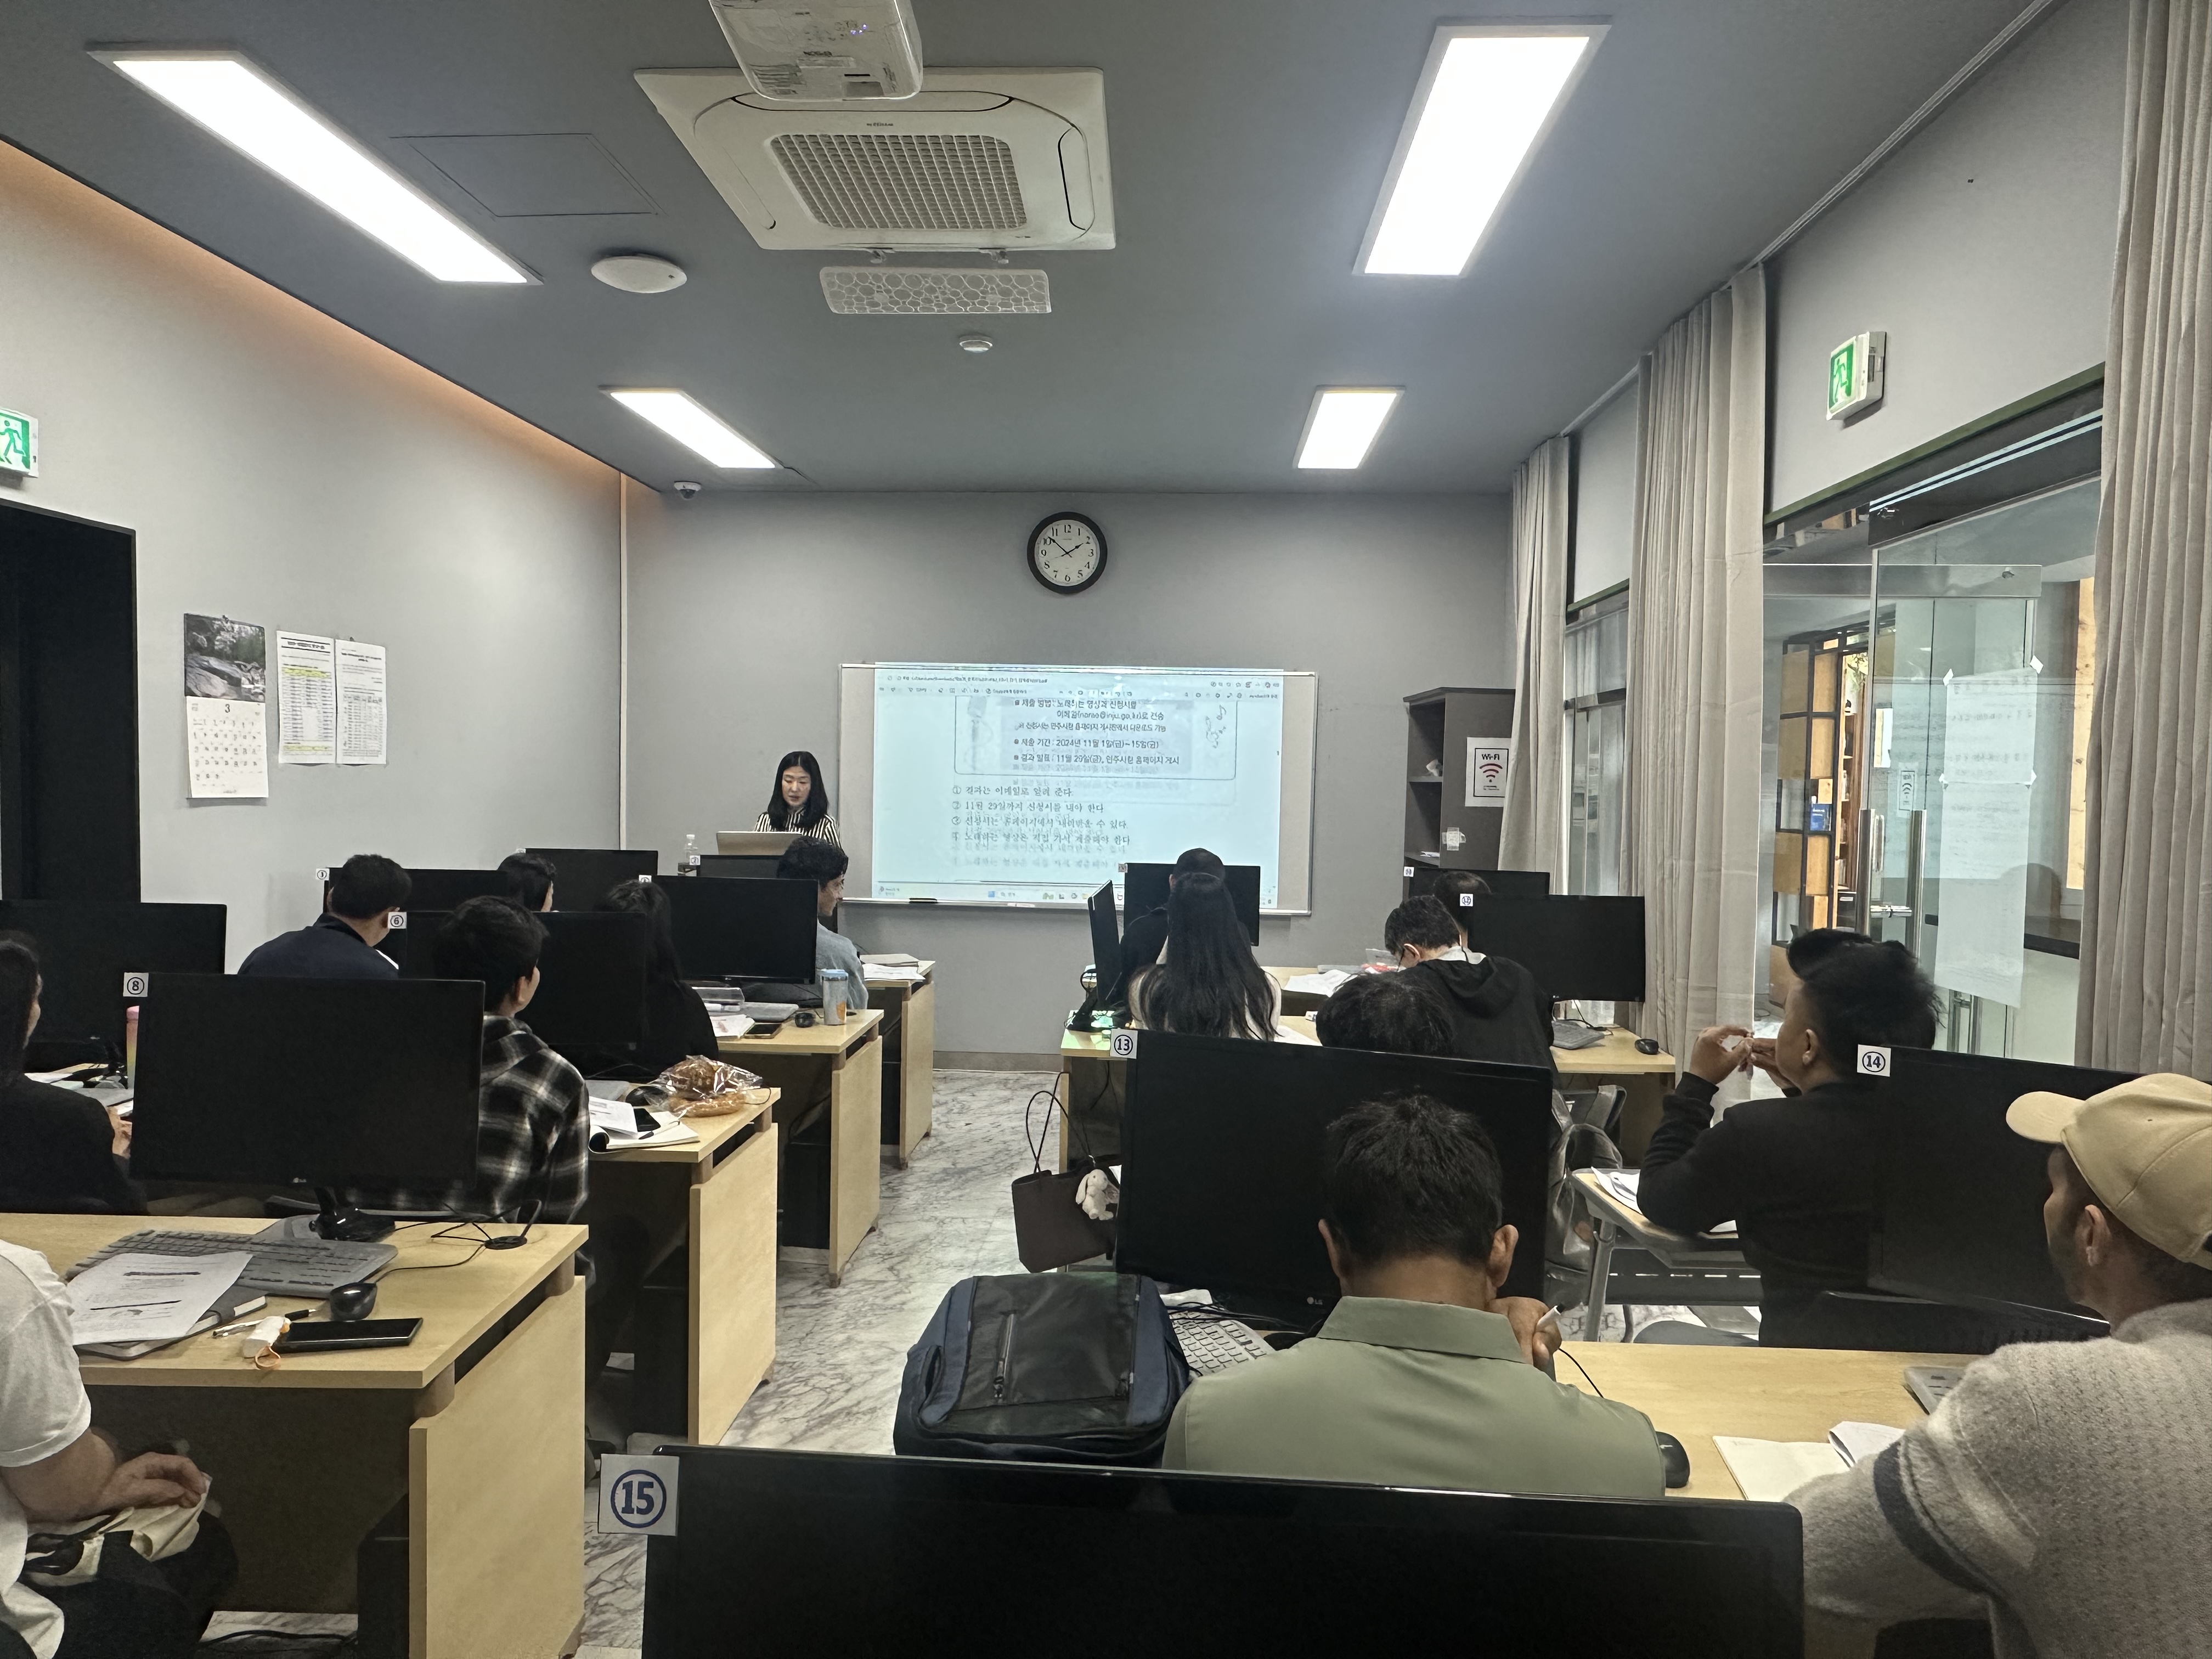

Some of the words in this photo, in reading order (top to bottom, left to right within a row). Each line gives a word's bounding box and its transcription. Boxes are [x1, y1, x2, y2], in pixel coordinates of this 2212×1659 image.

[1052, 527, 1058, 537] 11
[1064, 524, 1071, 533] 12
[1053, 570, 1058, 578] 7
[225, 704, 230, 713] 3
[621, 1480, 654, 1515] 15
